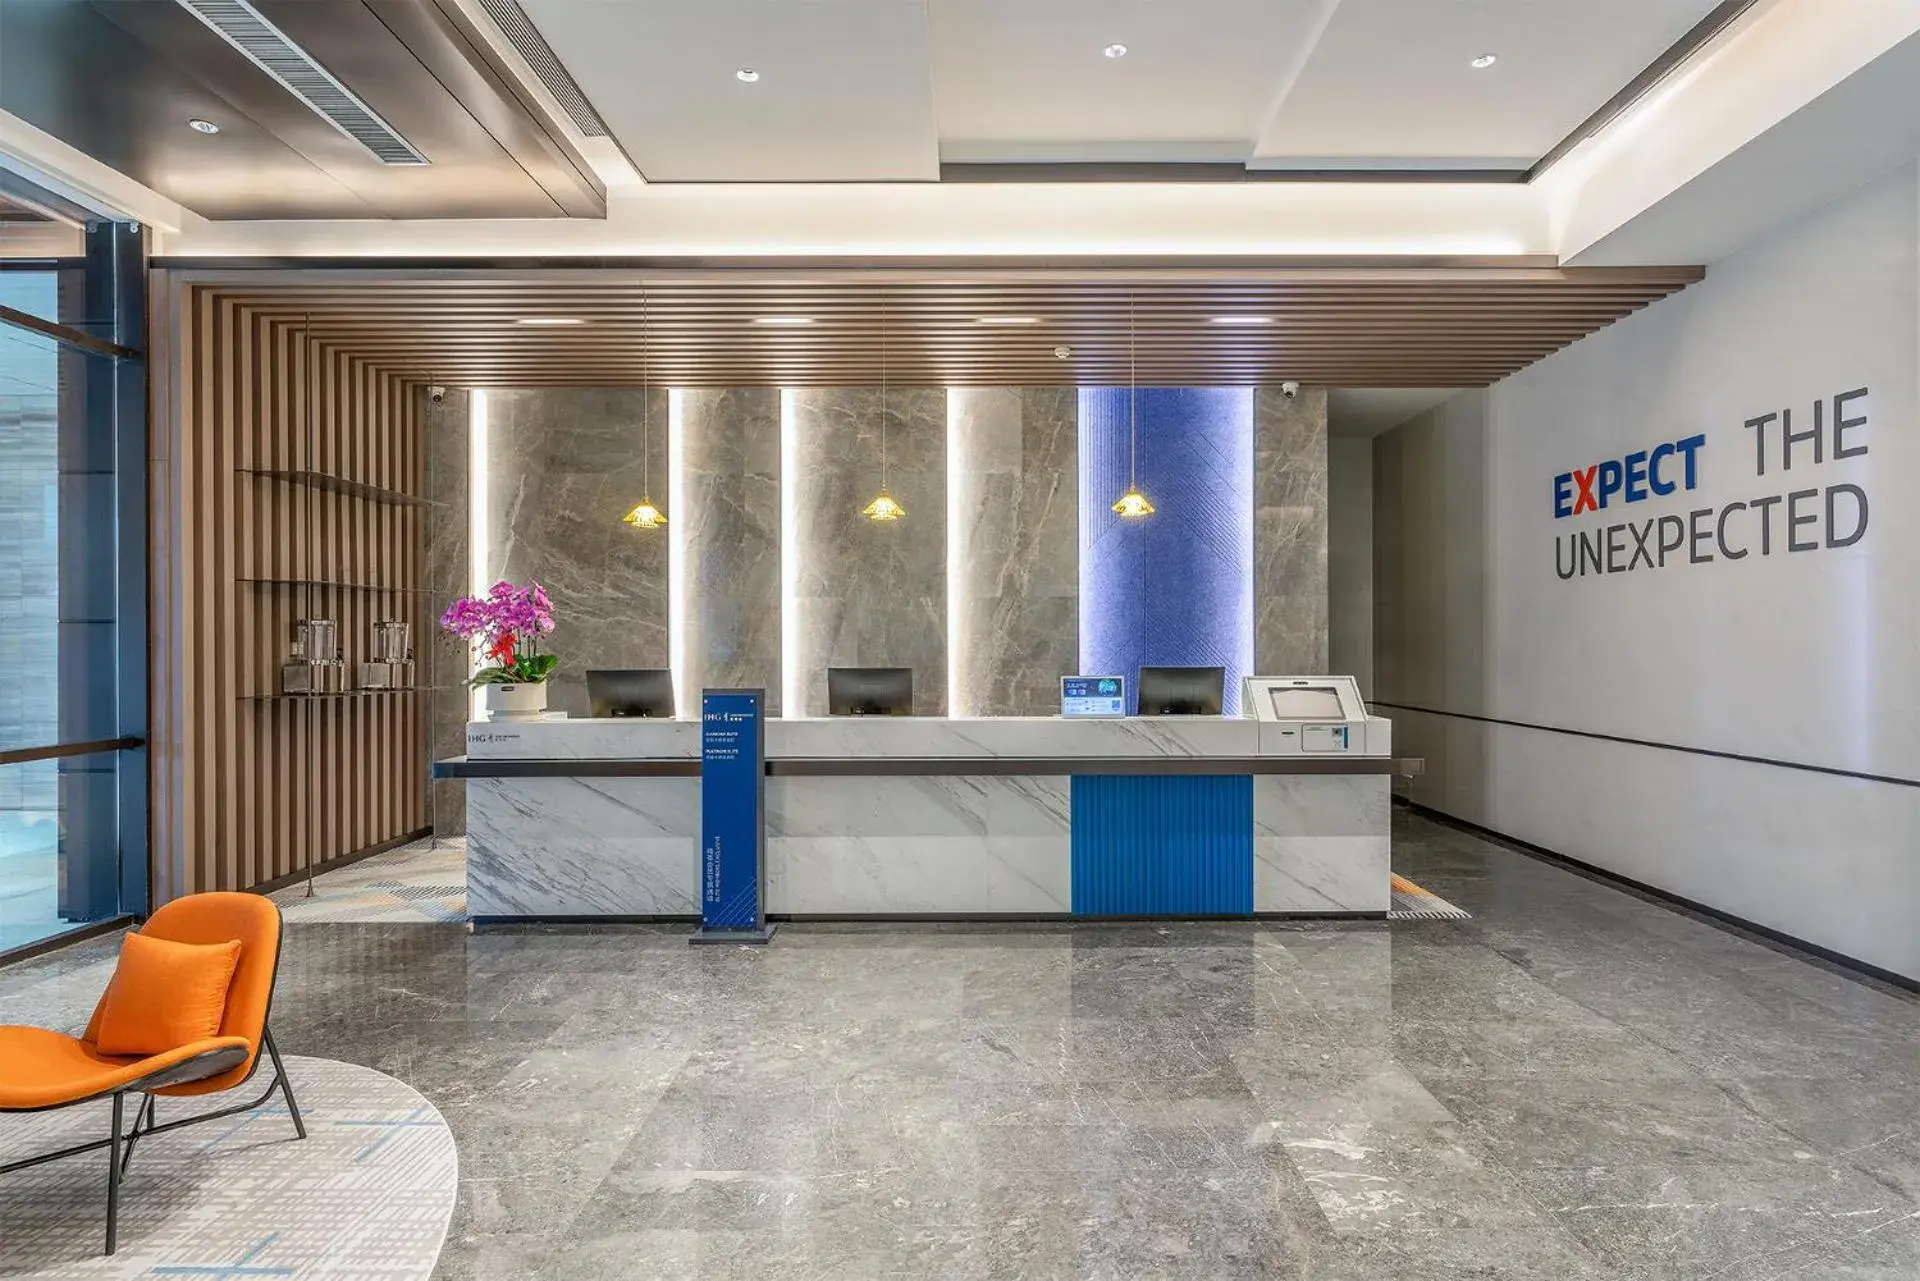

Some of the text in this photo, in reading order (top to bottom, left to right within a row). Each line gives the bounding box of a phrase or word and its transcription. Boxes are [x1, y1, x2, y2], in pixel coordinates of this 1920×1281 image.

[1554, 387, 1868, 518] EXPECT THE
[1556, 483, 1868, 579] UNEXPECTED
